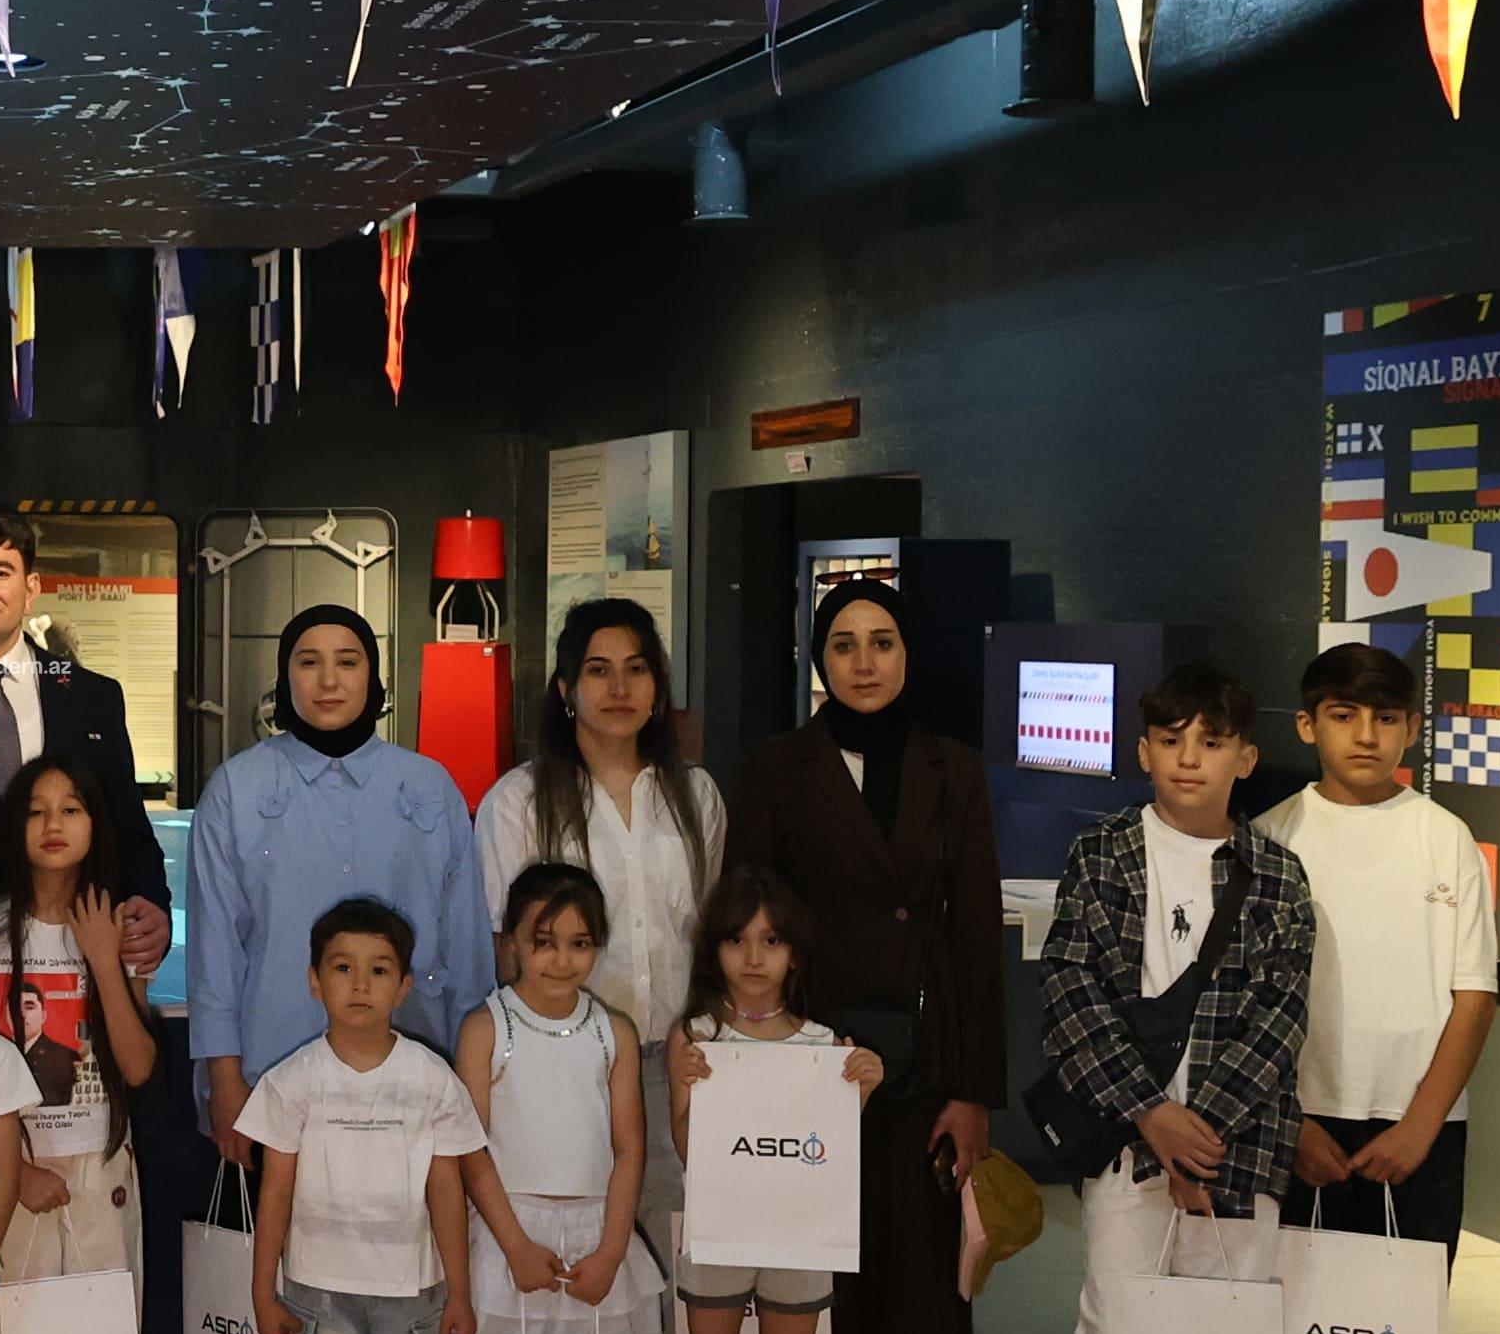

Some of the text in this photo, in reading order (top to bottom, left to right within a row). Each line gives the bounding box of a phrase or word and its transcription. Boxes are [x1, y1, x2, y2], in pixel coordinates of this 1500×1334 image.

[1477, 293, 1493, 322] 7
[1364, 359, 1446, 393] SİQNAL
[1367, 424, 1385, 452] X
[1401, 511, 1436, 525] WISH
[1438, 511, 1457, 525] TO
[1422, 619, 1435, 798] YOU SHOULD STOP YOU
[730, 1132, 826, 1166] ASCO
